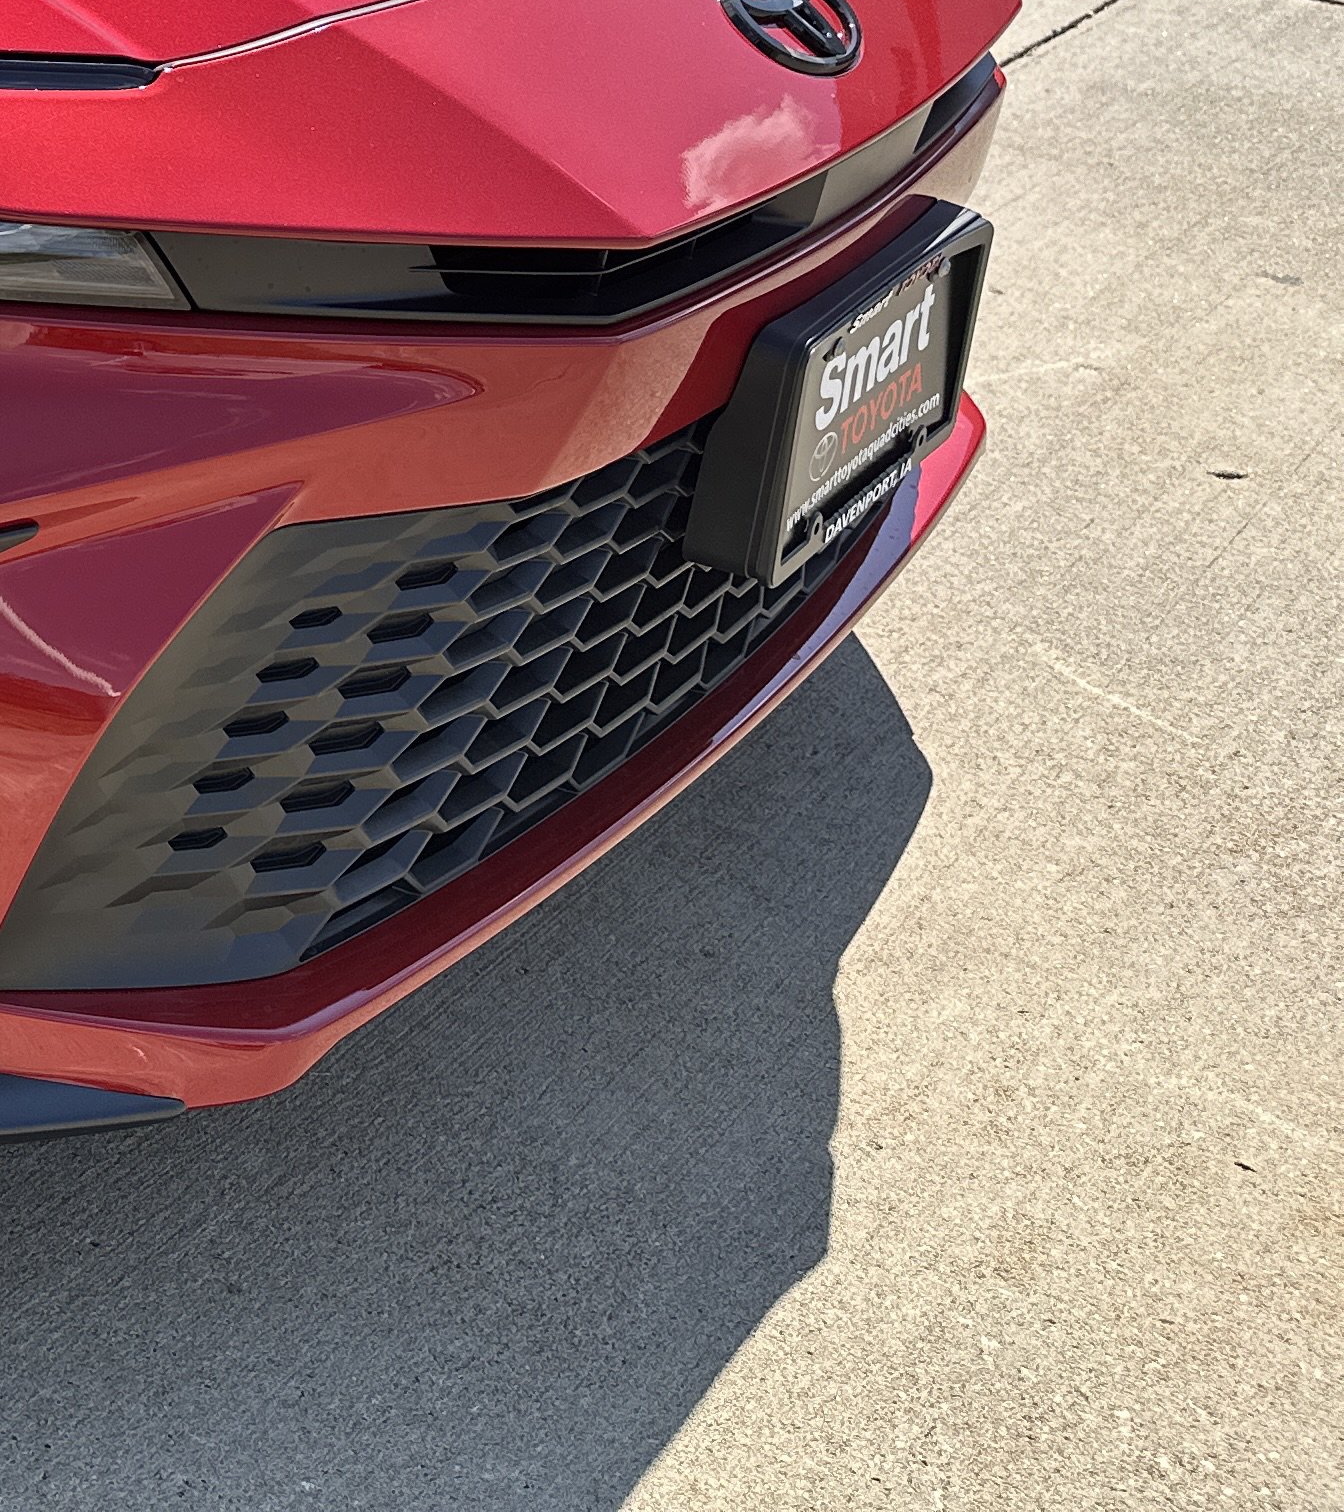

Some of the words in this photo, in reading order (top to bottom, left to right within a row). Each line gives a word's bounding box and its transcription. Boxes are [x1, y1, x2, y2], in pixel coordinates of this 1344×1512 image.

[815, 284, 935, 431] Smart
[849, 291, 894, 334] Smart
[840, 363, 923, 455] TOYOTA
[786, 392, 940, 532] www.smarttoyotaquadcities.com
[825, 468, 899, 544] DAVENPORT,
[900, 457, 912, 481] IA
